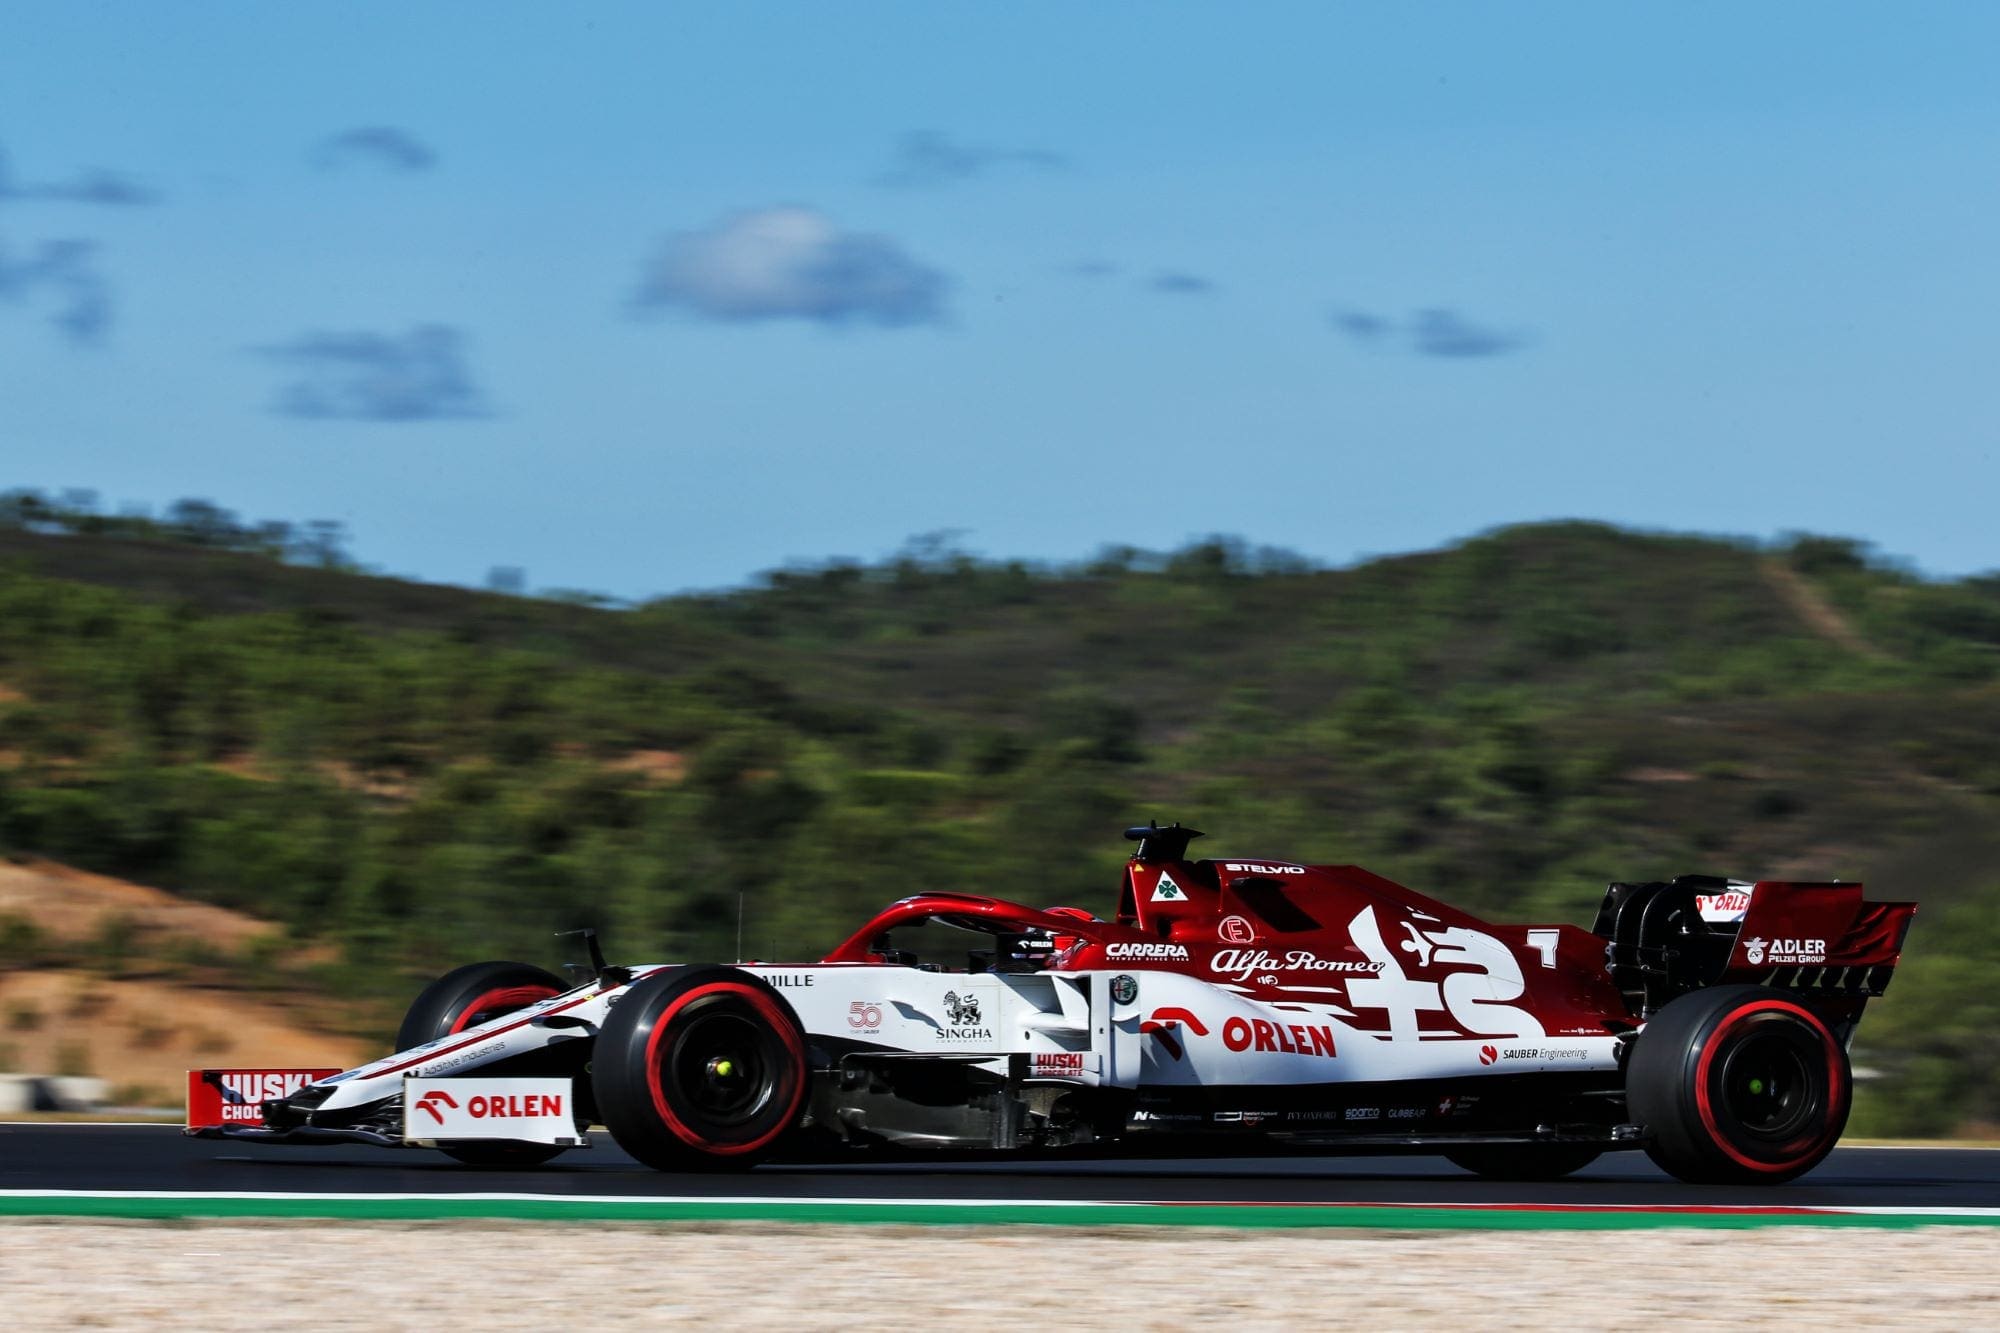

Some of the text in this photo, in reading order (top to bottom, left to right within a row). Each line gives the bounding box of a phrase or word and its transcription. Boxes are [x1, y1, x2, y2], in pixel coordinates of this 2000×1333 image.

[1225, 863, 1305, 874] STELVIO
[1106, 943, 1189, 957] CARRERA
[1769, 939, 1826, 954] ADLER
[1210, 949, 1386, 982] Alfa Romeo
[847, 1001, 882, 1028] 50
[935, 1028, 992, 1039] SINGHA
[1222, 1016, 1337, 1058] ORLEN
[1036, 1053, 1083, 1069] HUSKI
[1503, 1047, 1588, 1061] SAUBER Engineering
[221, 1105, 263, 1119] CHOC
[467, 1095, 562, 1119] ORLEN
[1345, 1108, 1380, 1120] sparco
